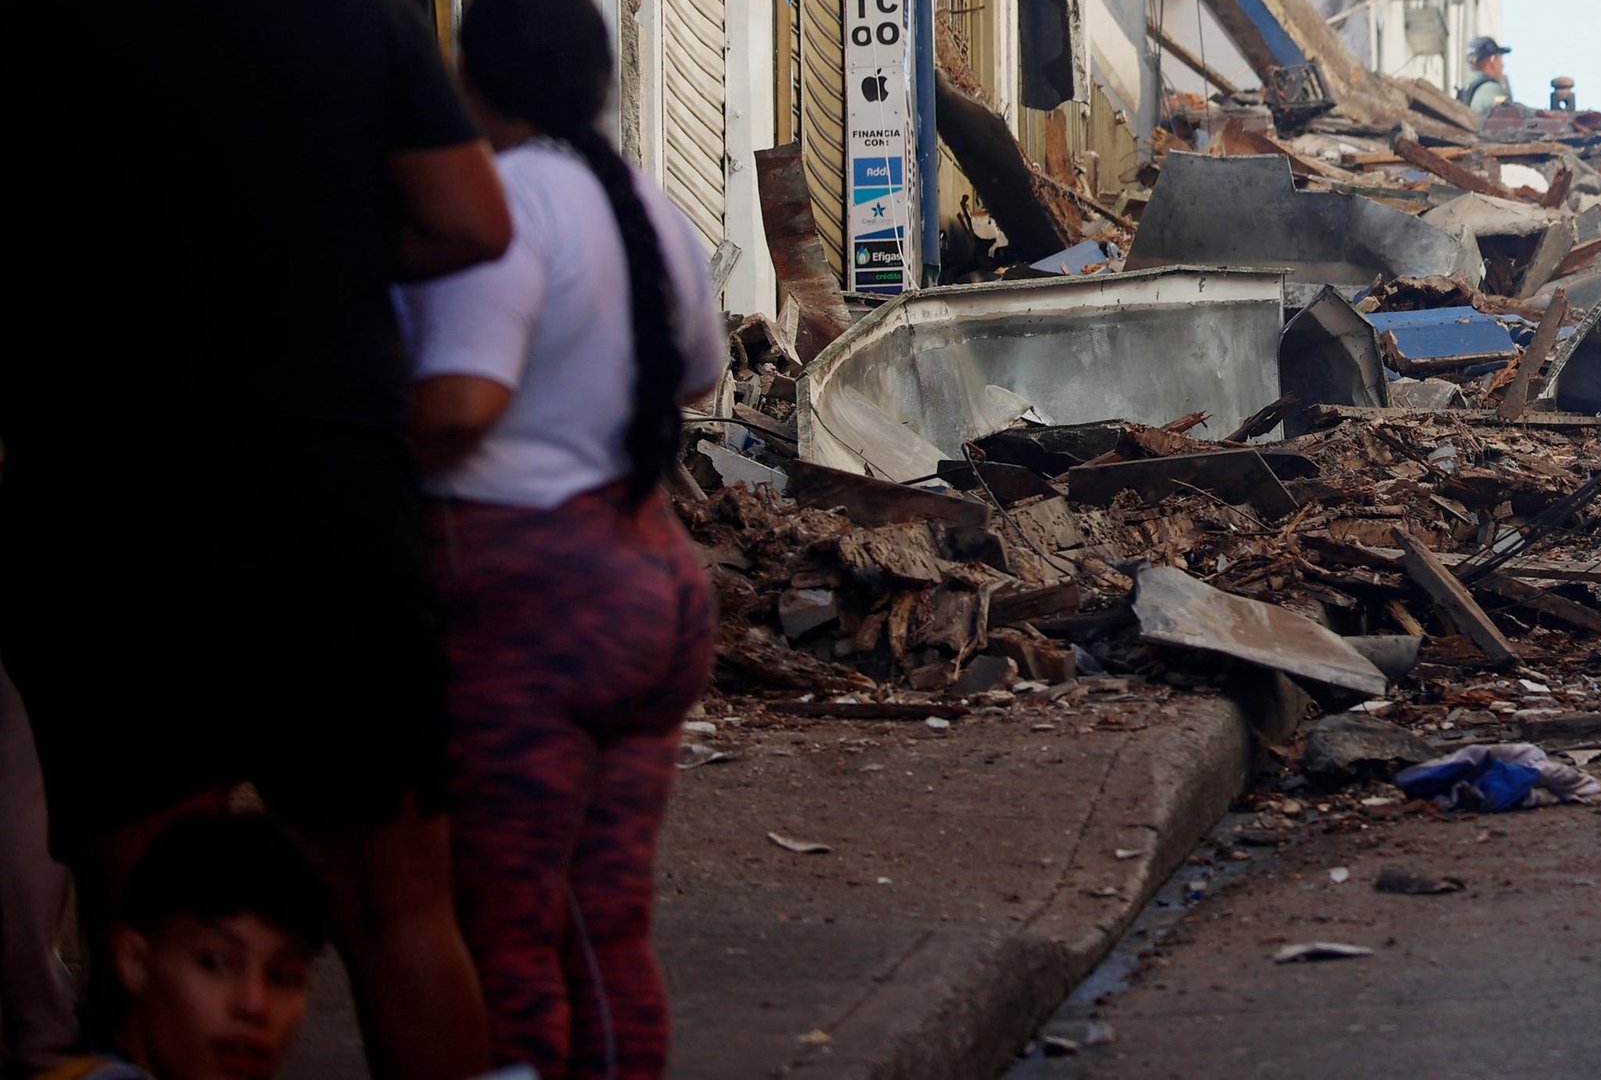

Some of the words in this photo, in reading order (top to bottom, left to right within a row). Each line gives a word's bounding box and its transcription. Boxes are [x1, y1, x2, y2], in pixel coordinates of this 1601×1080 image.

[852, 129, 901, 138] FINANCIA
[864, 138, 889, 147] CON:
[872, 251, 901, 263] Efigas
